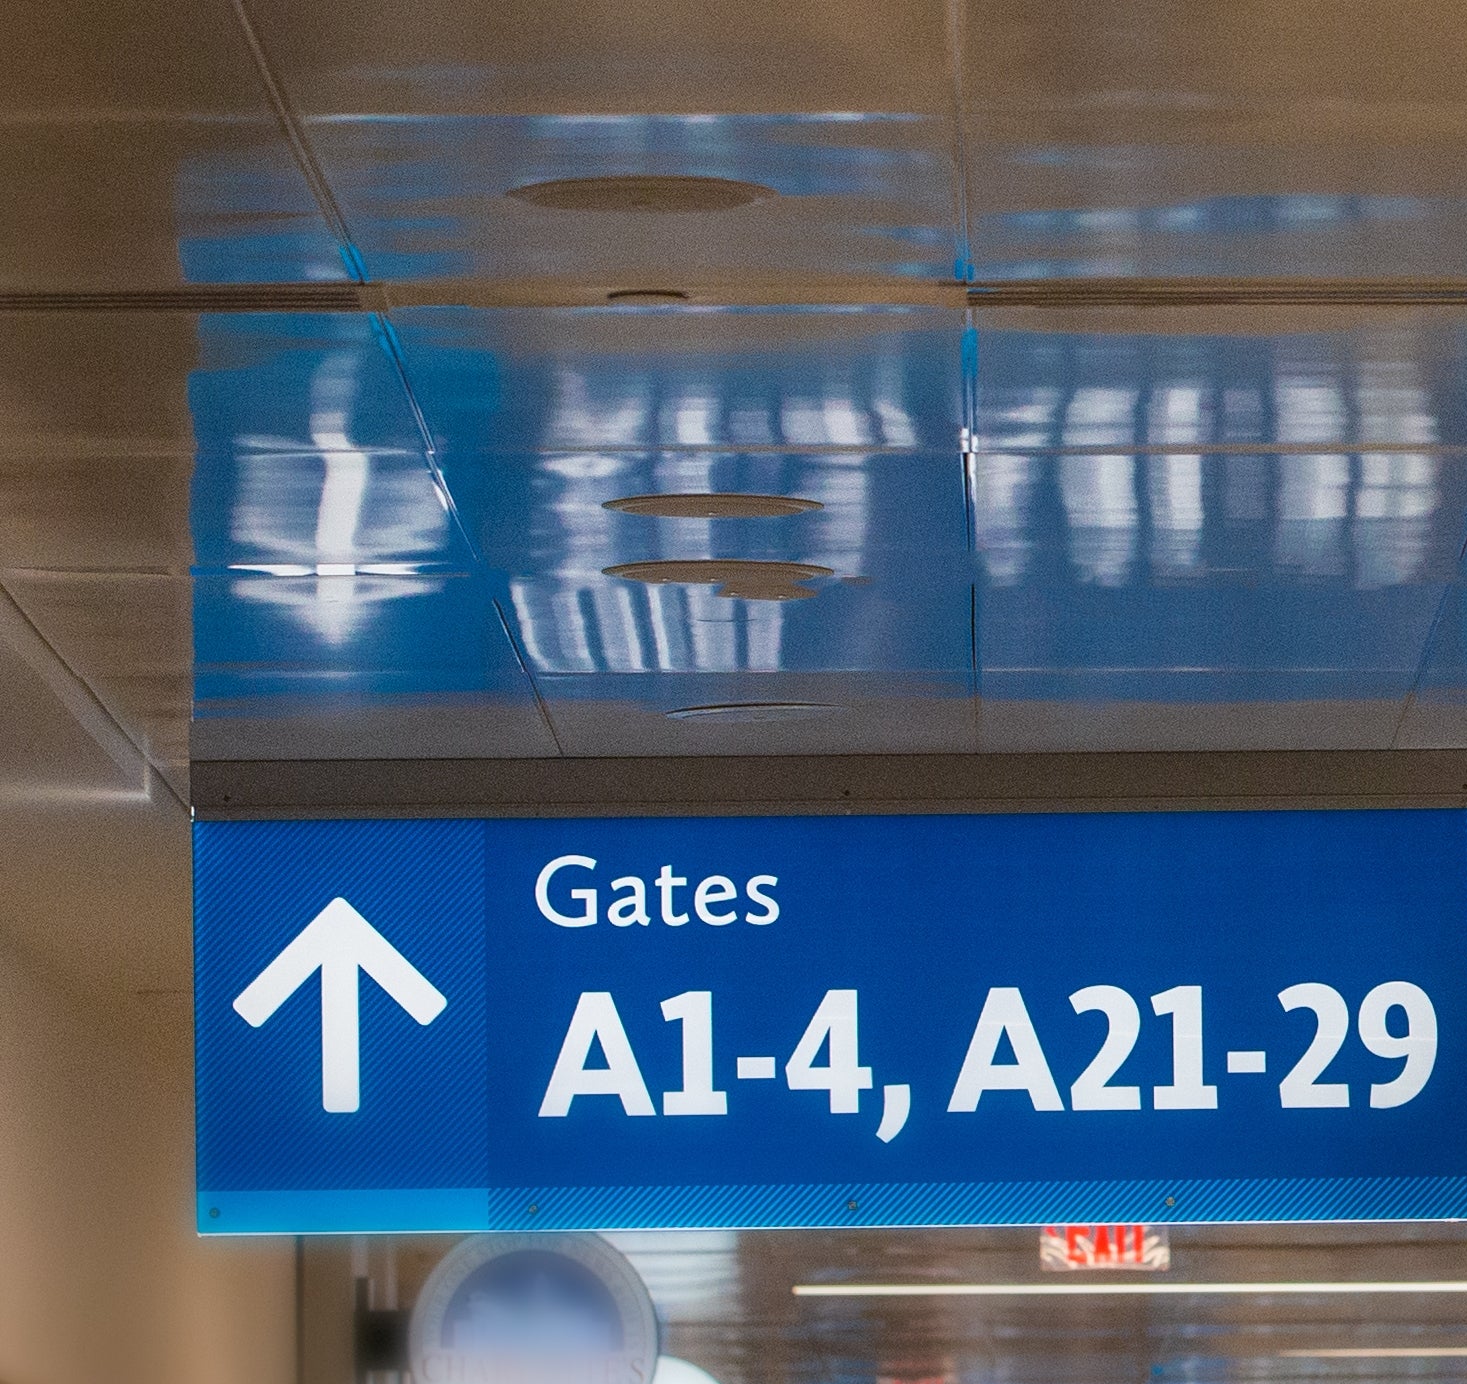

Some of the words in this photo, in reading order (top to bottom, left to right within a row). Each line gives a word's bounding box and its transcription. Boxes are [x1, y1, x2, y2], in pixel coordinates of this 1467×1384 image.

[534, 854, 780, 928] Gates
[537, 989, 911, 1144] A1-4,
[946, 980, 1438, 1113] A21-29
